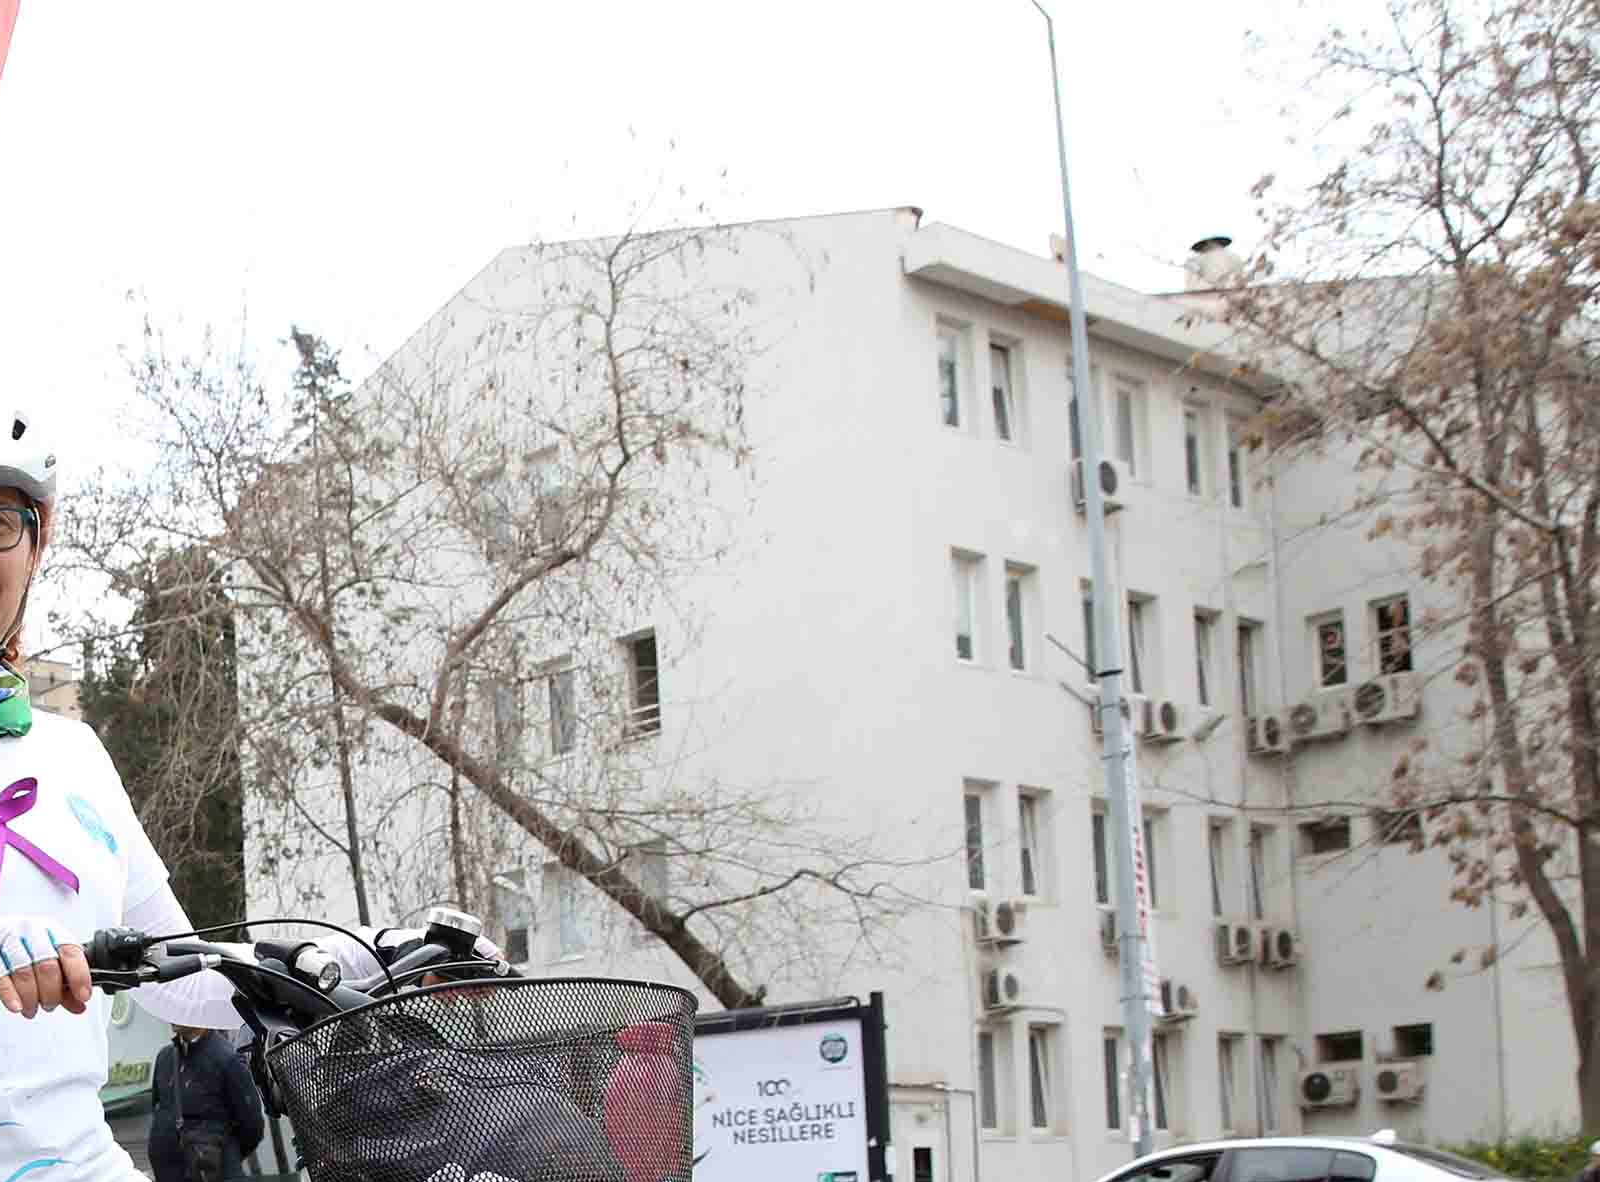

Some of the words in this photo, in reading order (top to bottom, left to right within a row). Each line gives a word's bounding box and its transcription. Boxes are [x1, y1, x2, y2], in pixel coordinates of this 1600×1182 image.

[712, 1107, 760, 1129] NİCE
[762, 1102, 856, 1124] SAĞLIKLI
[733, 1122, 836, 1145] NESİLLERE
